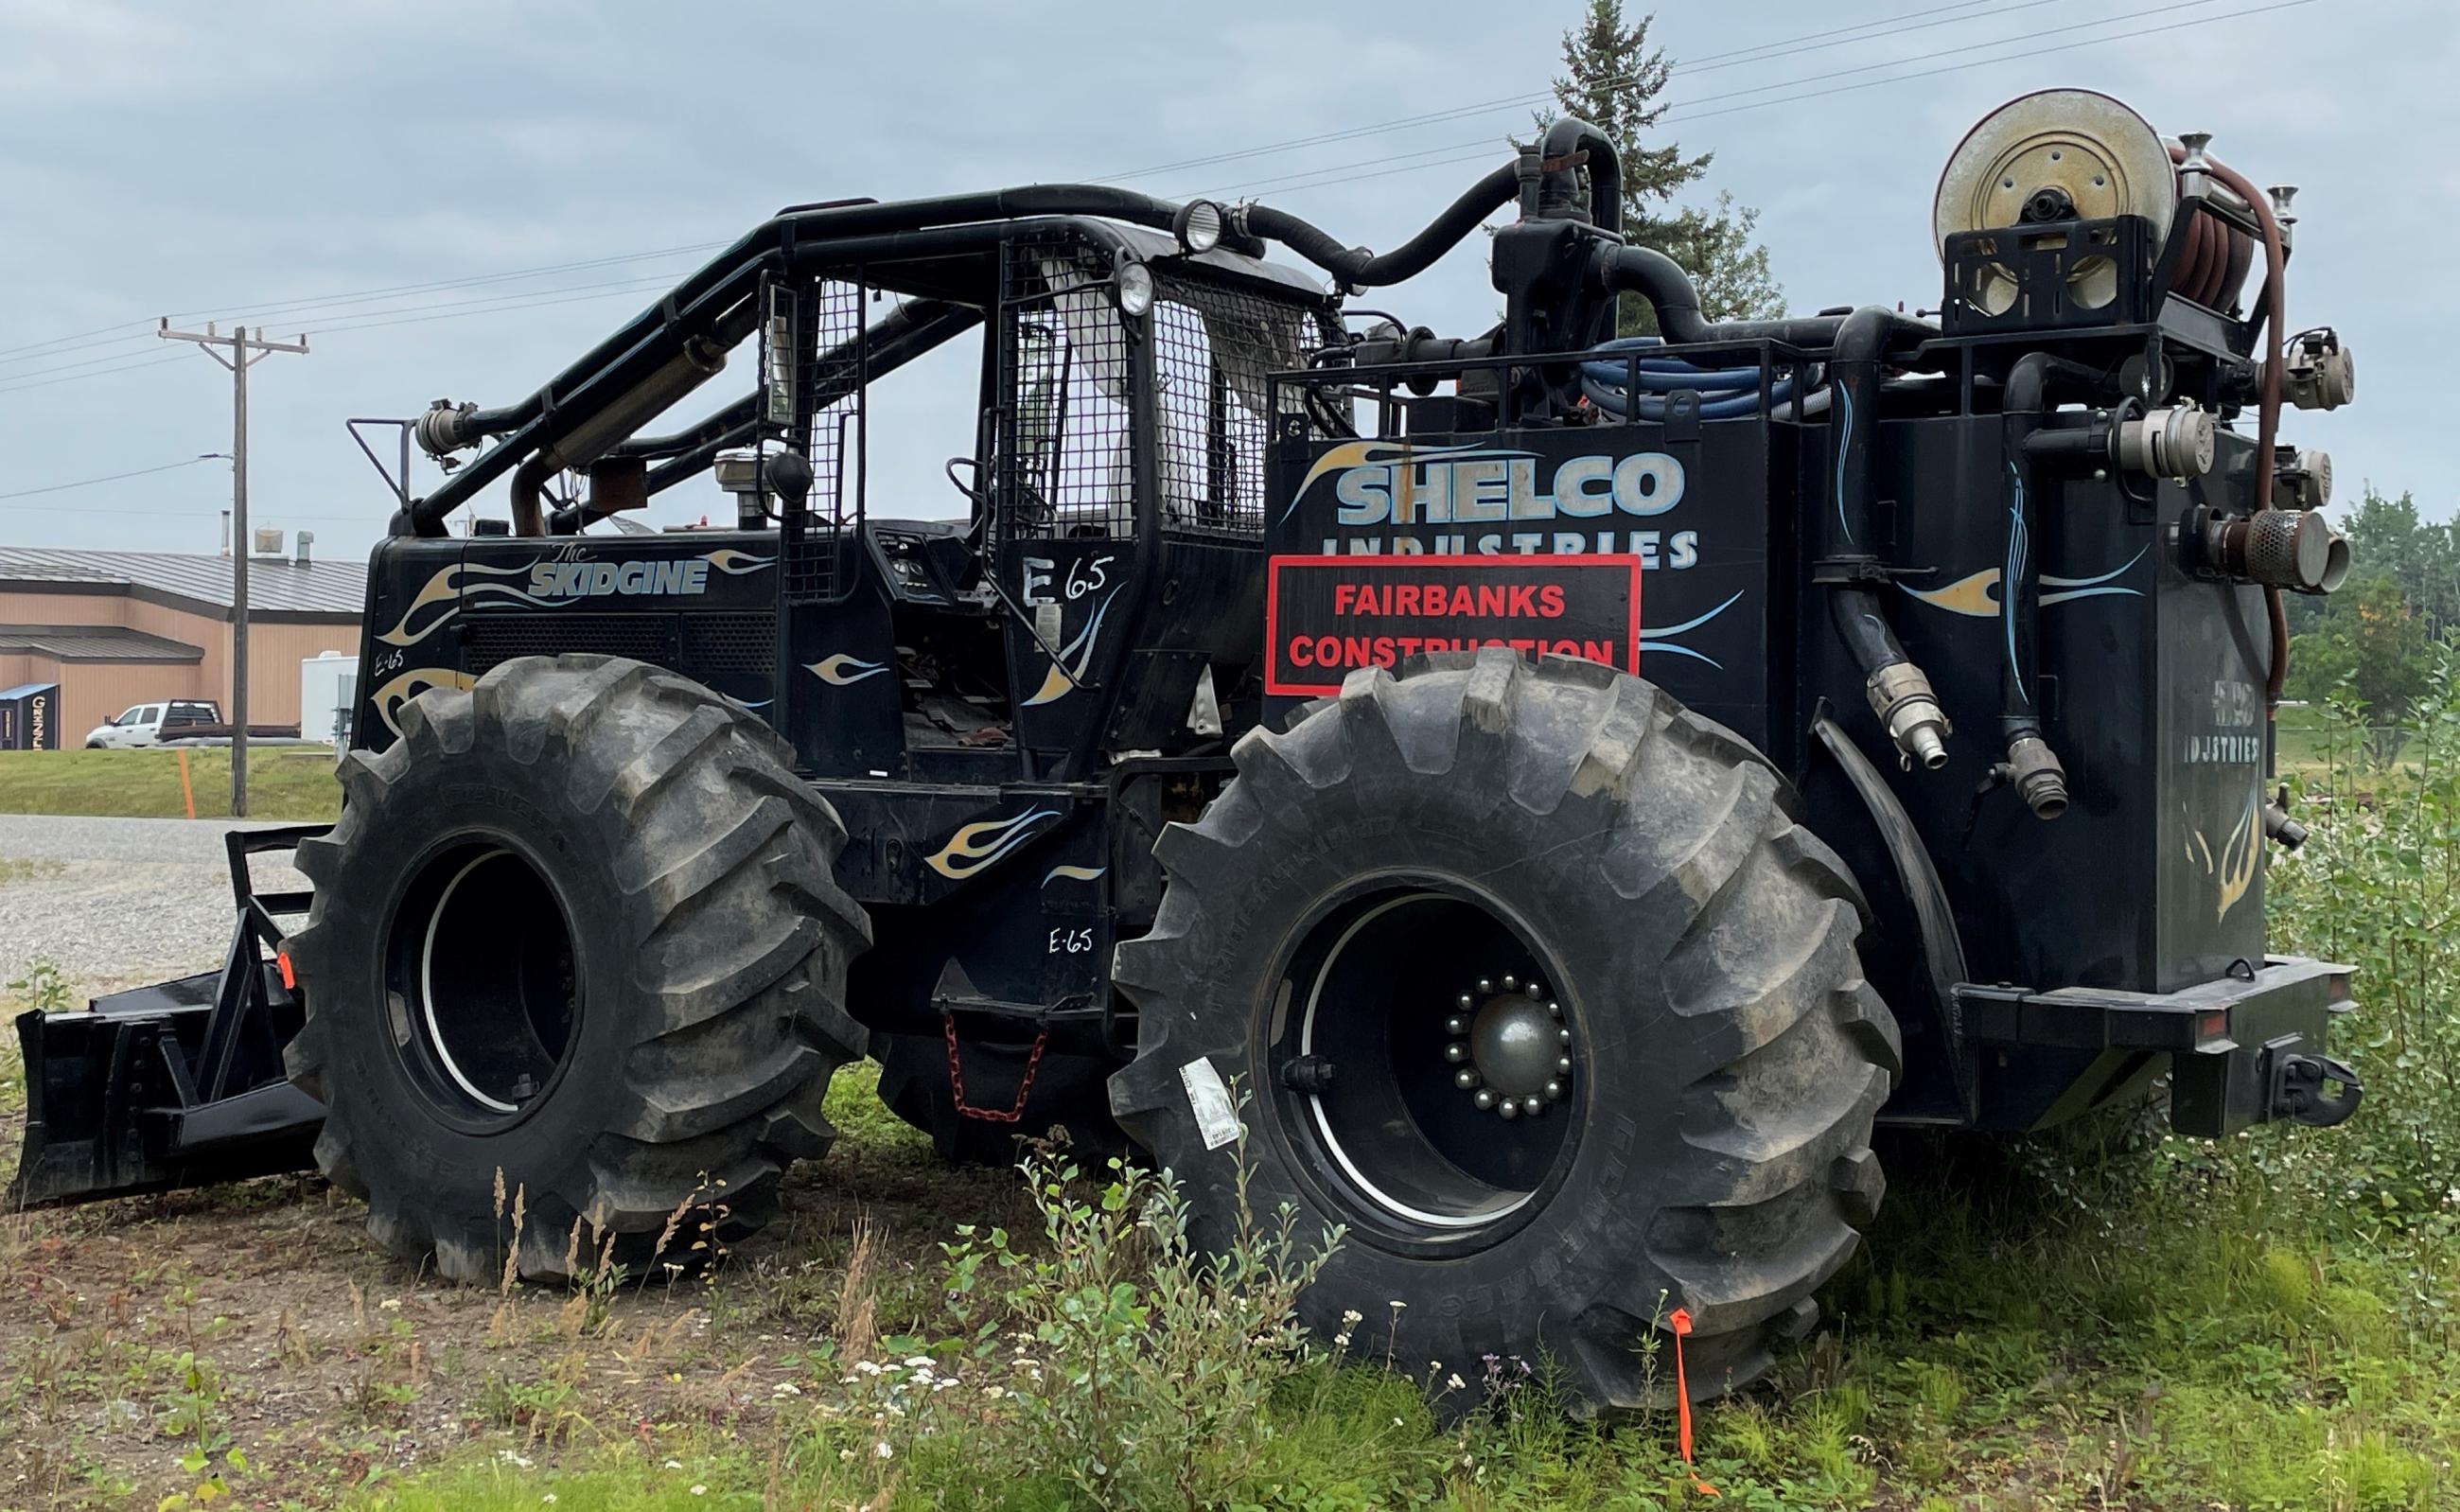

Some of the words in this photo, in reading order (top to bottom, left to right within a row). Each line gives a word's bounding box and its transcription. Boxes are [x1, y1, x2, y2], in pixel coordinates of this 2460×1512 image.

[1337, 451, 1685, 525] SHELCO
[551, 542, 598, 563] The
[527, 560, 710, 597] SKIDGINE
[1064, 555, 1115, 600] 65
[1335, 585, 1566, 618] FAIRBANKS
[374, 648, 404, 677] E-65
